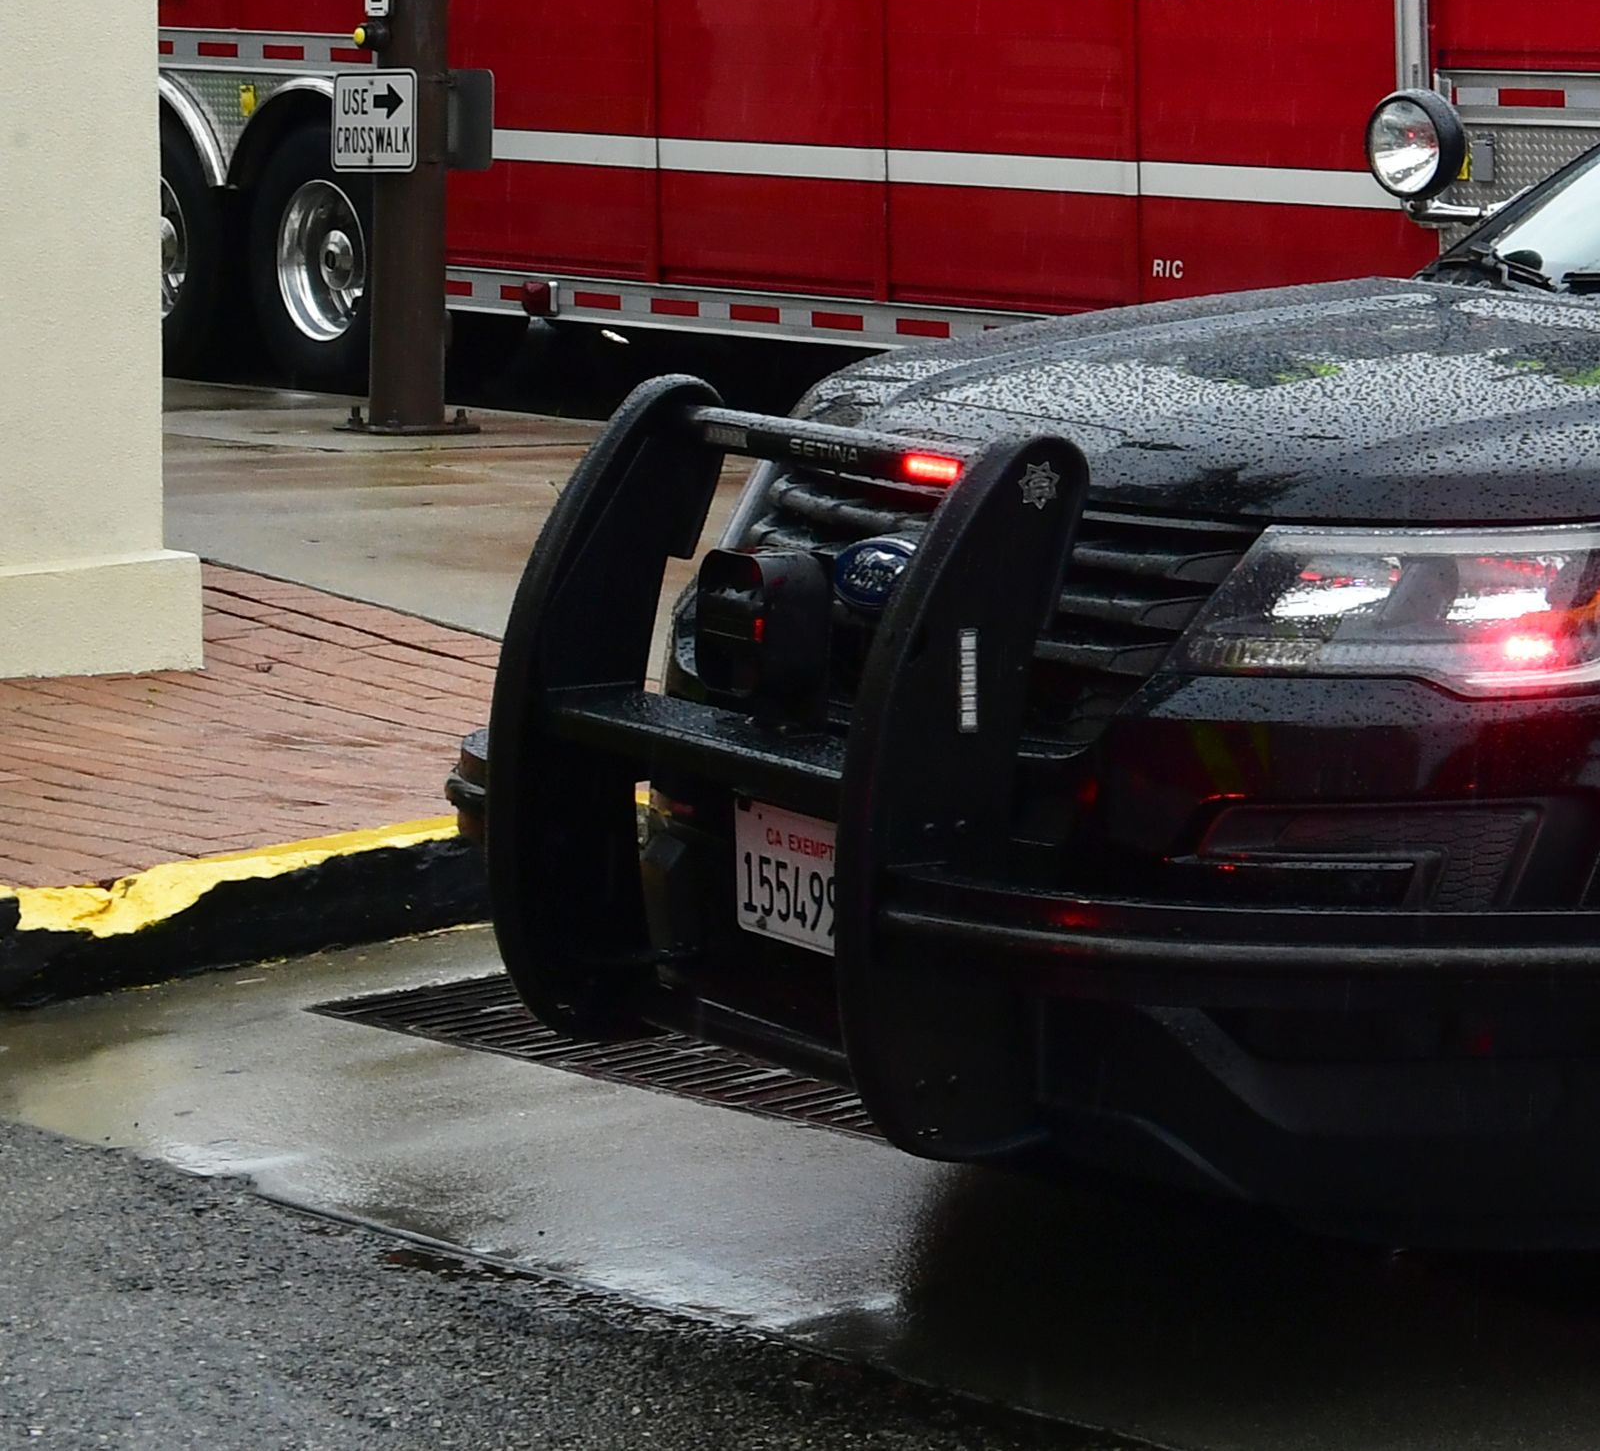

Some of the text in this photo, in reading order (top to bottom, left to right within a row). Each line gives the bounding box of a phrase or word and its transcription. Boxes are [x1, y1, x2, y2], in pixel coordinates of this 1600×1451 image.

[342, 89, 369, 115] USE
[336, 126, 410, 154] CROSSWALK
[1152, 259, 1184, 279] RIC
[789, 438, 860, 463] SETINA
[766, 827, 835, 863] CA EXEMPT
